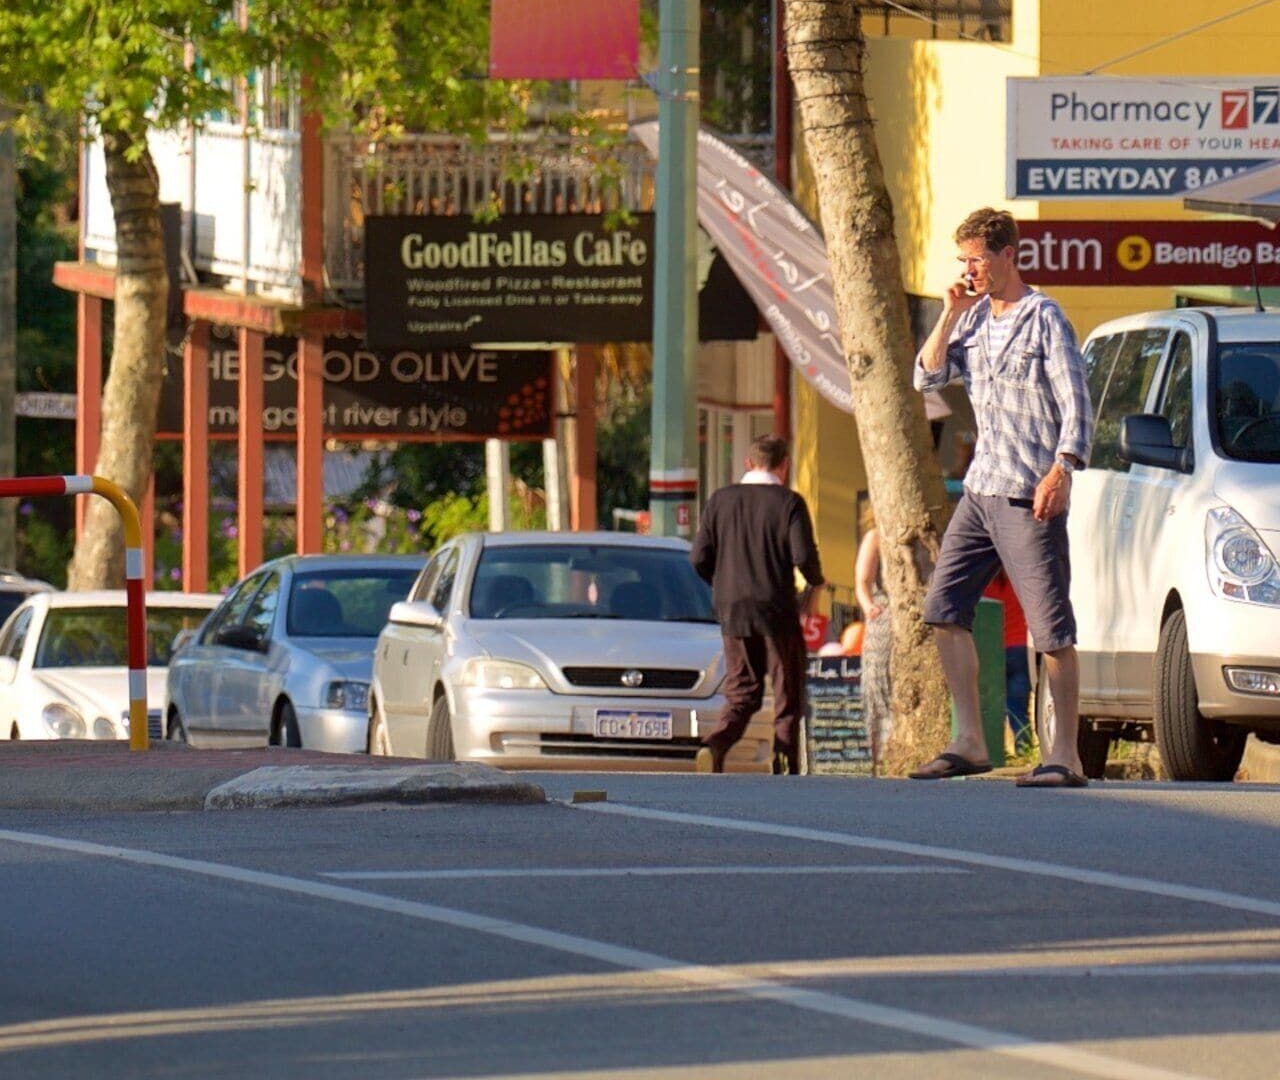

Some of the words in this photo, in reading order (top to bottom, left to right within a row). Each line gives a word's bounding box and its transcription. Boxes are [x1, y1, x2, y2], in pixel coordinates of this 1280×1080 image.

[1051, 93, 1212, 129] Pharmacy
[1052, 137, 1113, 150] TAKING
[1120, 137, 1162, 150] CARE
[1169, 137, 1191, 150] OF
[1198, 136, 1243, 150] YOUR
[1028, 167, 1177, 190] EVERYDAY
[1018, 232, 1102, 271] atm
[1155, 242, 1252, 269] Bendigo
[391, 349, 498, 382] OLIVE
[343, 403, 401, 426] river
[407, 402, 467, 429] style
